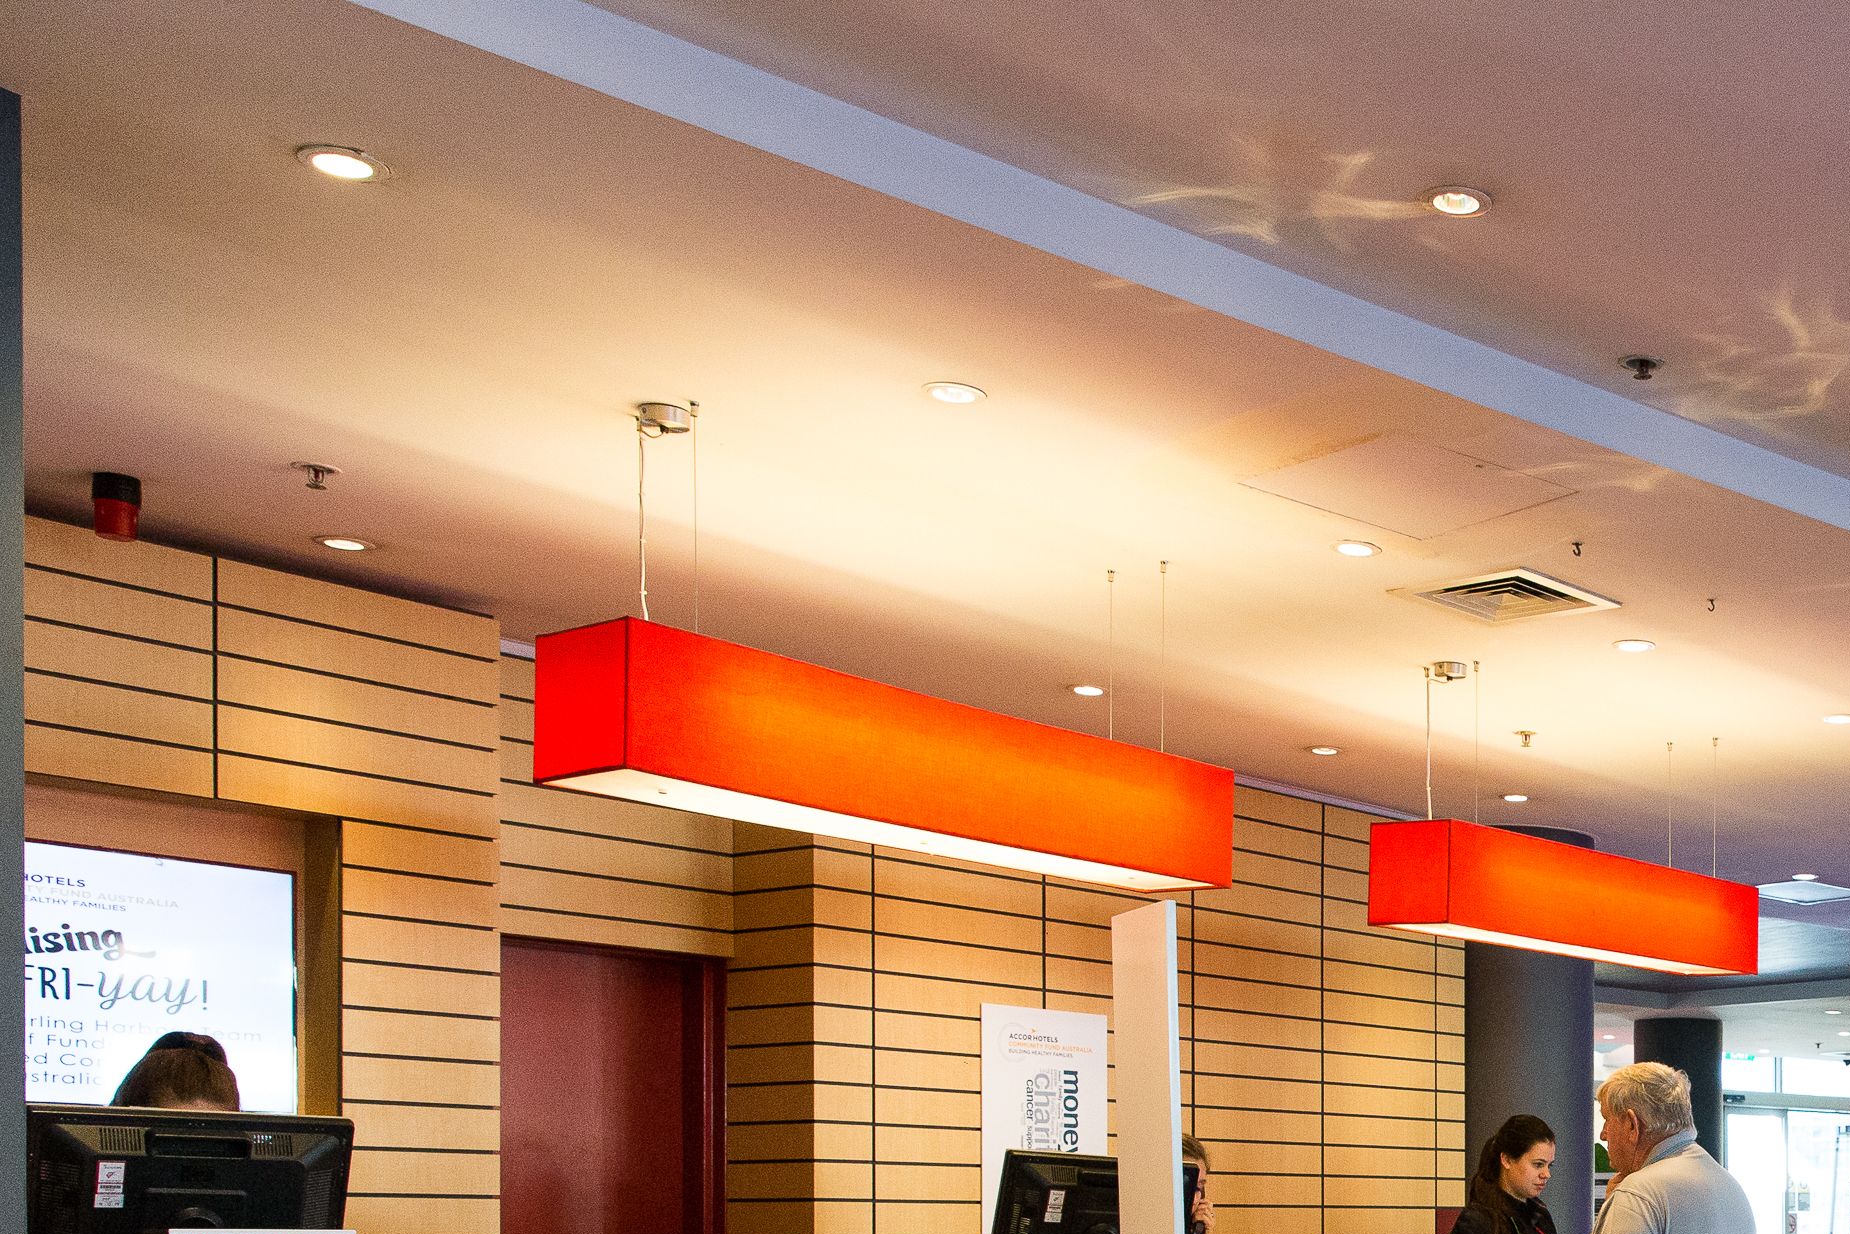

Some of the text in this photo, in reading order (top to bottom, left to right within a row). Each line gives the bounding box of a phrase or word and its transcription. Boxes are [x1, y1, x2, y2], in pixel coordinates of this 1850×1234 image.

[73, 900, 127, 911] FAMILIES
[98, 892, 179, 909] AUSTRALIA
[1009, 1033, 1058, 1043] ACCORHOTELS
[1008, 1041, 1043, 1049] COMMUNITY
[1062, 1045, 1093, 1054] AUSTRALIA
[1026, 1079, 1034, 1121] cancer
